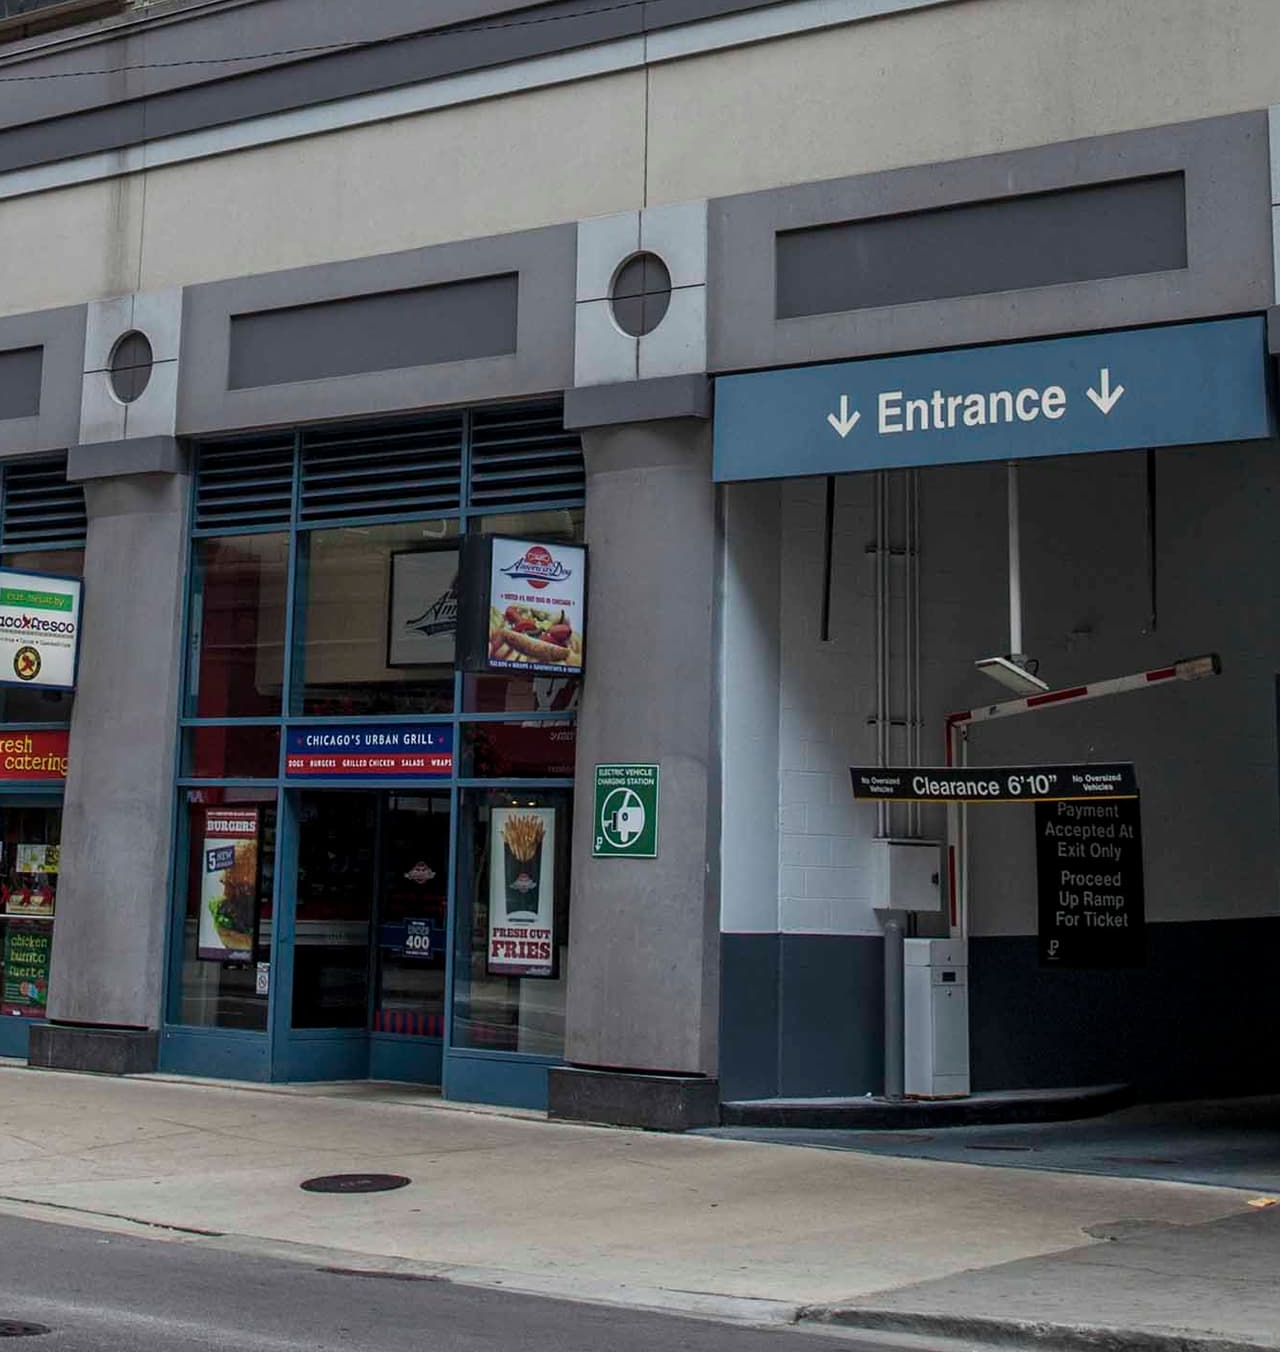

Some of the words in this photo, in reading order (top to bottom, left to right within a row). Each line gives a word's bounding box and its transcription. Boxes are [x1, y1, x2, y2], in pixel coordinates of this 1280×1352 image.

[878, 384, 1067, 435] Entrance
[31, 617, 75, 634] fresco
[306, 734, 361, 746] CHICAGO'S
[365, 734, 399, 745] URBAN
[403, 733, 434, 745] GRILL
[4, 752, 68, 775] catering
[288, 759, 304, 768] DOGS
[310, 759, 336, 767] BURGERS
[342, 759, 367, 767] GRILLED
[369, 759, 395, 767] CHICKEN
[401, 759, 424, 767] SALADS
[431, 758, 452, 767] WRAPS
[598, 768, 625, 777] ELECTRIC
[625, 768, 653, 776] VEHICLE
[1072, 775, 1084, 783] No
[1085, 773, 1122, 783] Oversized
[871, 776, 900, 786] Oversized
[912, 775, 1000, 796] Clearance
[1082, 782, 1114, 792] Vehicles
[1057, 802, 1119, 820] Payment
[207, 820, 257, 833] BURGERS
[1045, 821, 1115, 840] Accepted
[1118, 824, 1133, 838] At
[1058, 842, 1086, 857] Exit
[1090, 843, 1122, 862] Only
[209, 852, 216, 870] 5
[1061, 871, 1122, 887] Proceed
[1059, 891, 1079, 908] Up
[1083, 891, 1124, 910] Ramp
[1055, 911, 1080, 928] For
[1086, 911, 1129, 928] Ticket
[493, 927, 528, 938] FRESH
[529, 929, 551, 939] CUT
[10, 936, 48, 948] chicken
[406, 935, 430, 950] 400
[491, 940, 551, 960] FRIES
